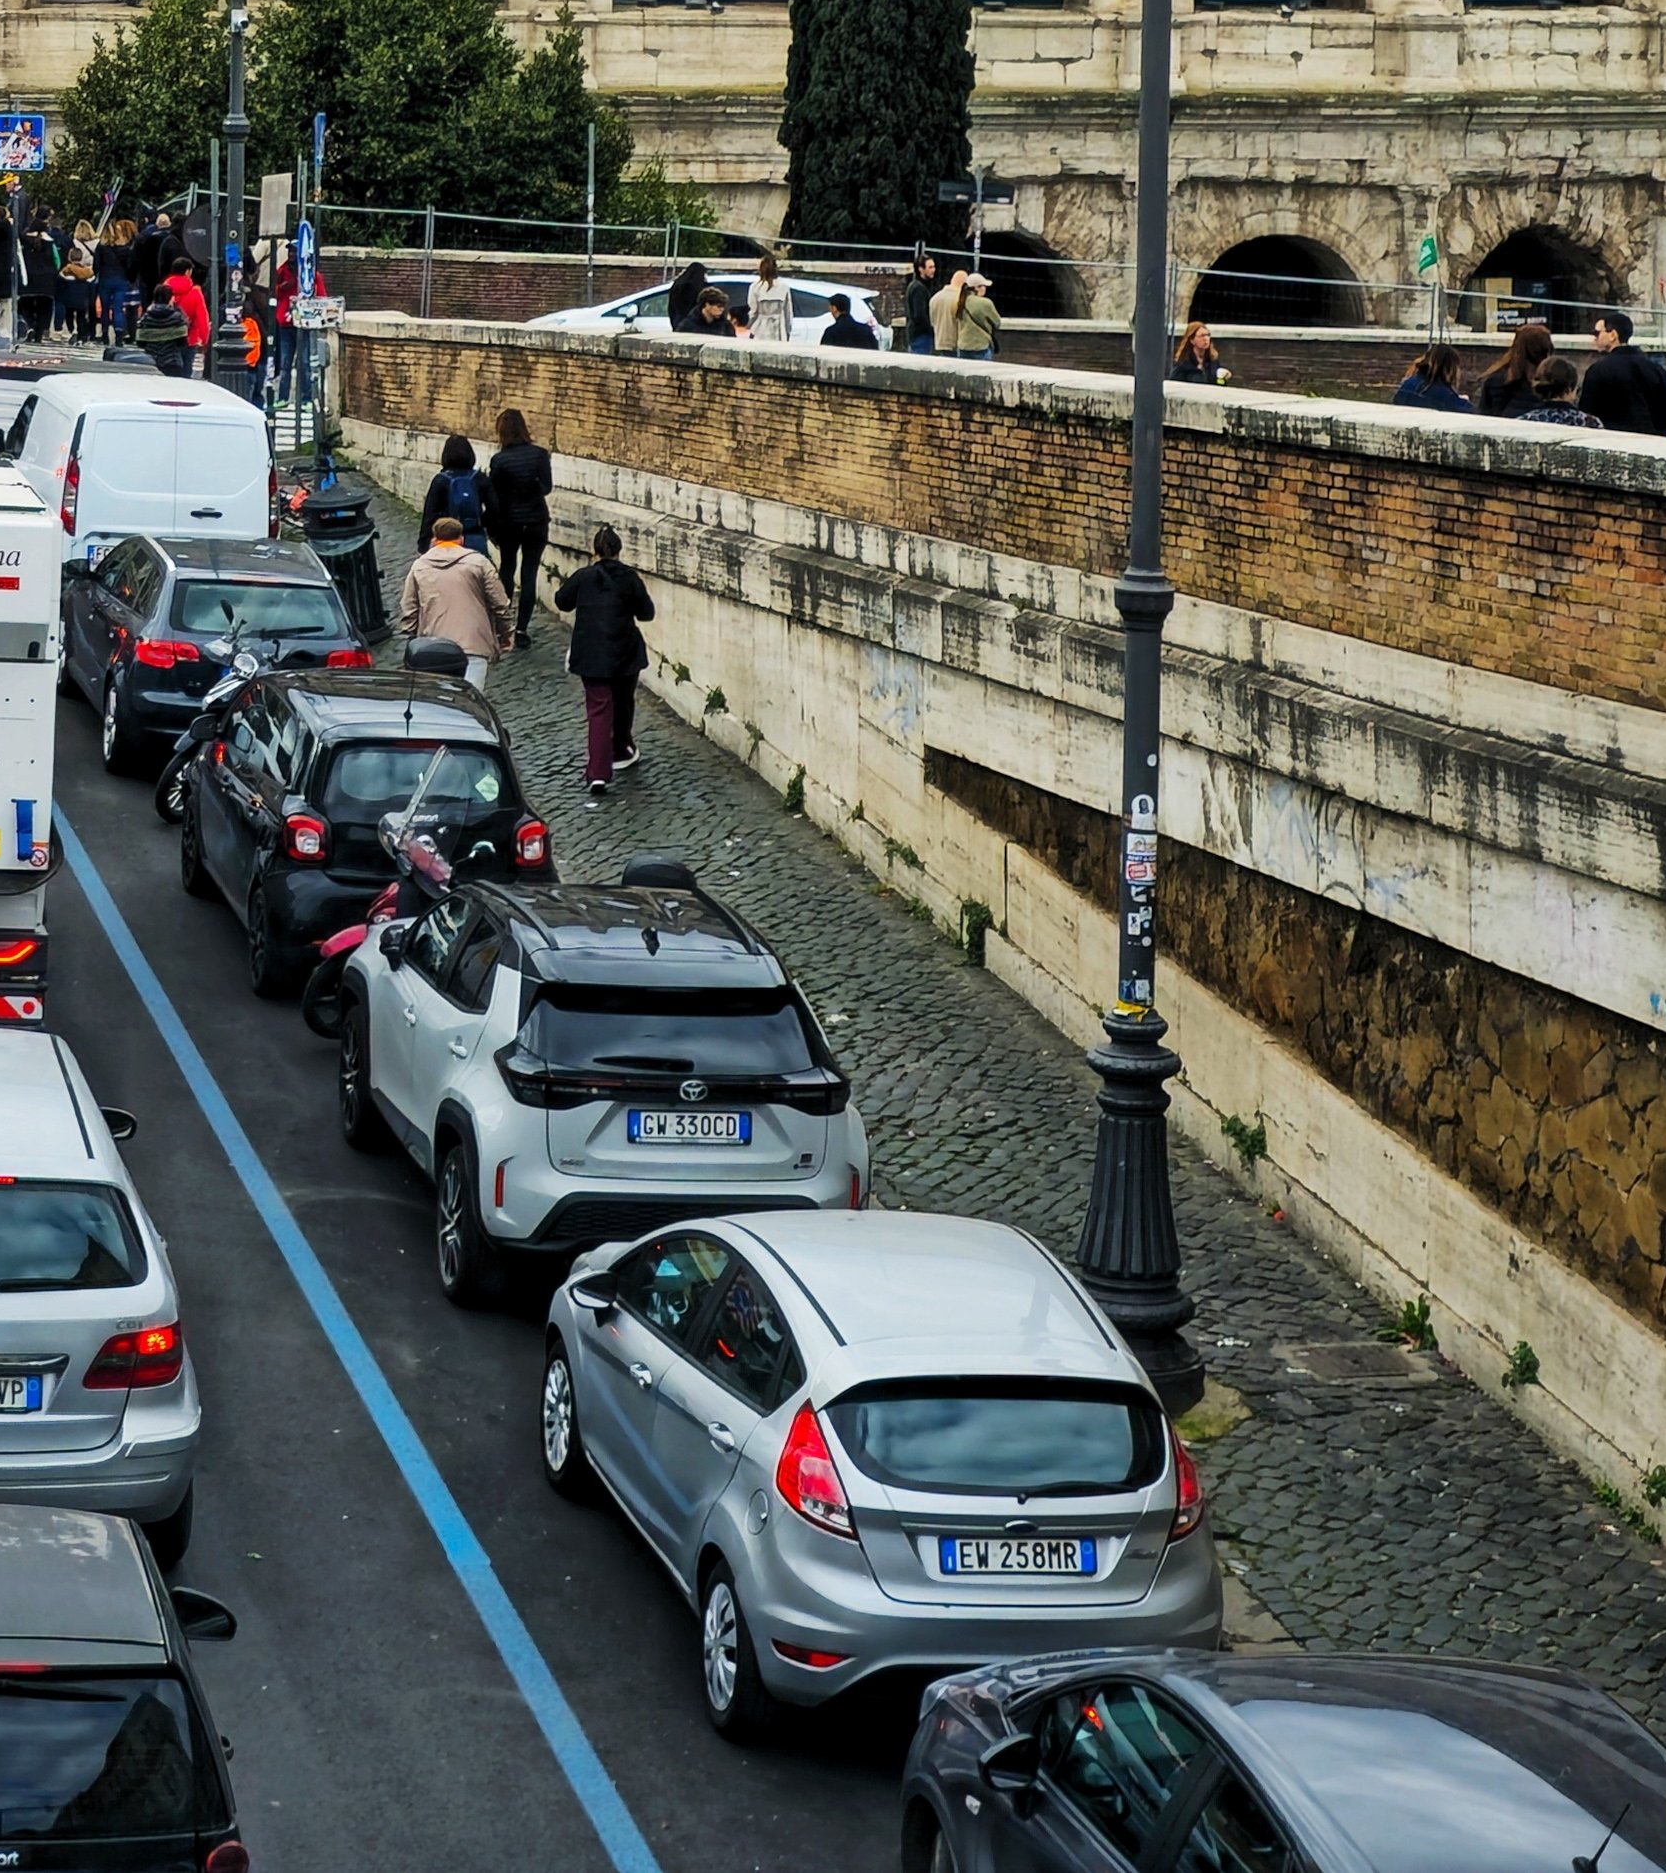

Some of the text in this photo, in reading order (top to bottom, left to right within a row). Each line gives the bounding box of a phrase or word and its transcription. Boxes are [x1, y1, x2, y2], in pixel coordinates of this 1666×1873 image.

[643, 1116, 667, 1136] GW
[675, 1115, 737, 1136] 330CD
[959, 1541, 990, 1570] EW
[1000, 1541, 1078, 1569] 258MR
